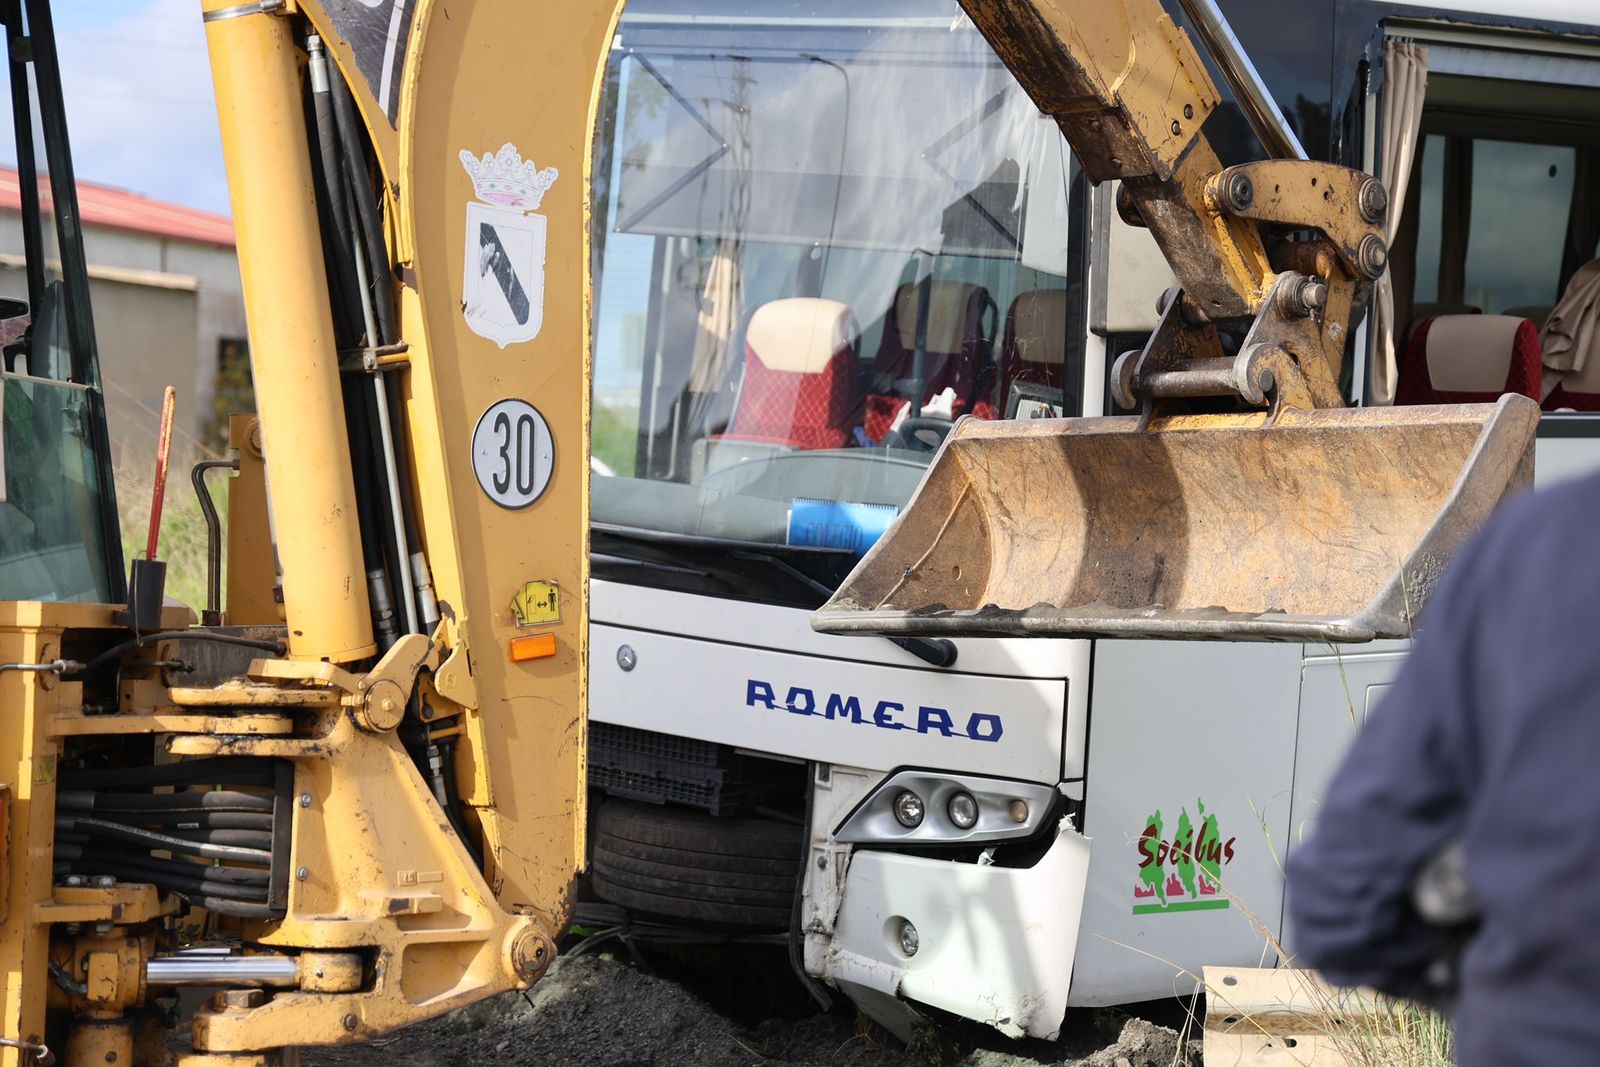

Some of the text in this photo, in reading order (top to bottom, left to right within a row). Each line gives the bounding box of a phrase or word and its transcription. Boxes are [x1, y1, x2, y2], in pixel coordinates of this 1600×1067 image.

[493, 412, 535, 495] 30
[746, 679, 1003, 742] ROMERO
[1138, 821, 1236, 868] Socibus
